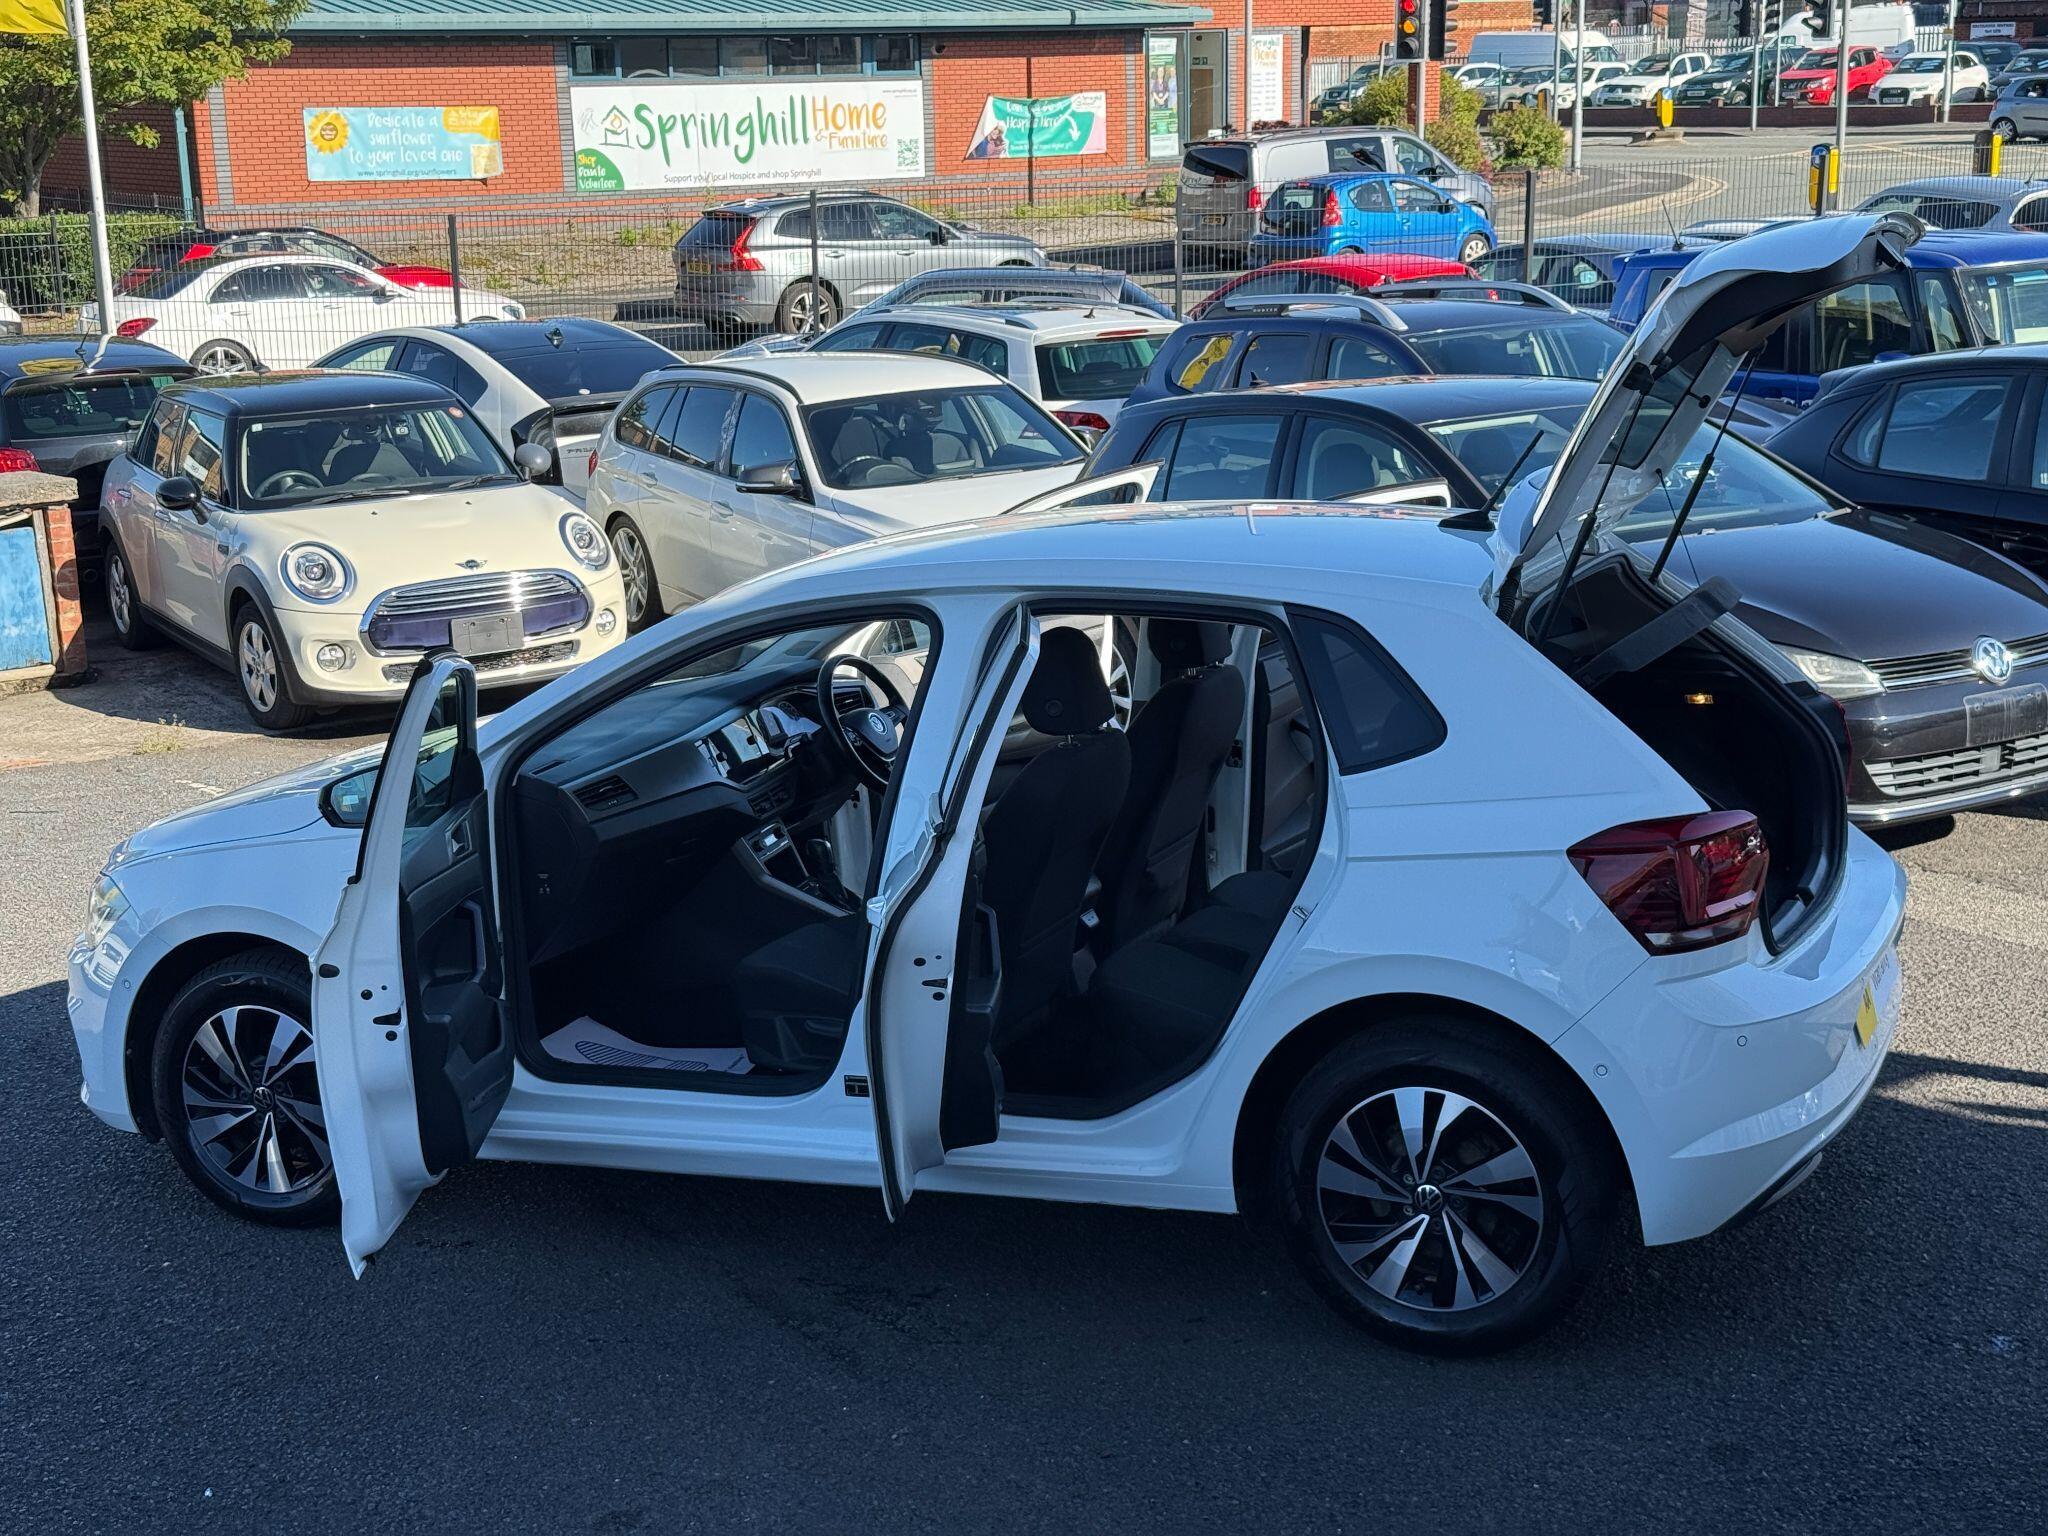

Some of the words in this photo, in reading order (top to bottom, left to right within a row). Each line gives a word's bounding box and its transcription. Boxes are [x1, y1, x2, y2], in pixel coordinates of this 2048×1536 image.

[367, 112, 426, 128] Dedicate
[429, 113, 438, 128] a
[370, 128, 433, 146] sunflower
[633, 94, 810, 168] Springhill
[812, 95, 887, 131] Home
[829, 130, 888, 150] Furniture
[349, 147, 364, 164] to
[367, 150, 396, 168] your
[400, 146, 437, 163] loved
[441, 149, 464, 163] one
[664, 174, 693, 184] Support
[694, 174, 711, 184] your
[712, 171, 728, 181] local
[729, 171, 755, 182] Hospice
[757, 170, 771, 179] and
[772, 169, 789, 180] shop
[790, 168, 822, 179] Springhill
